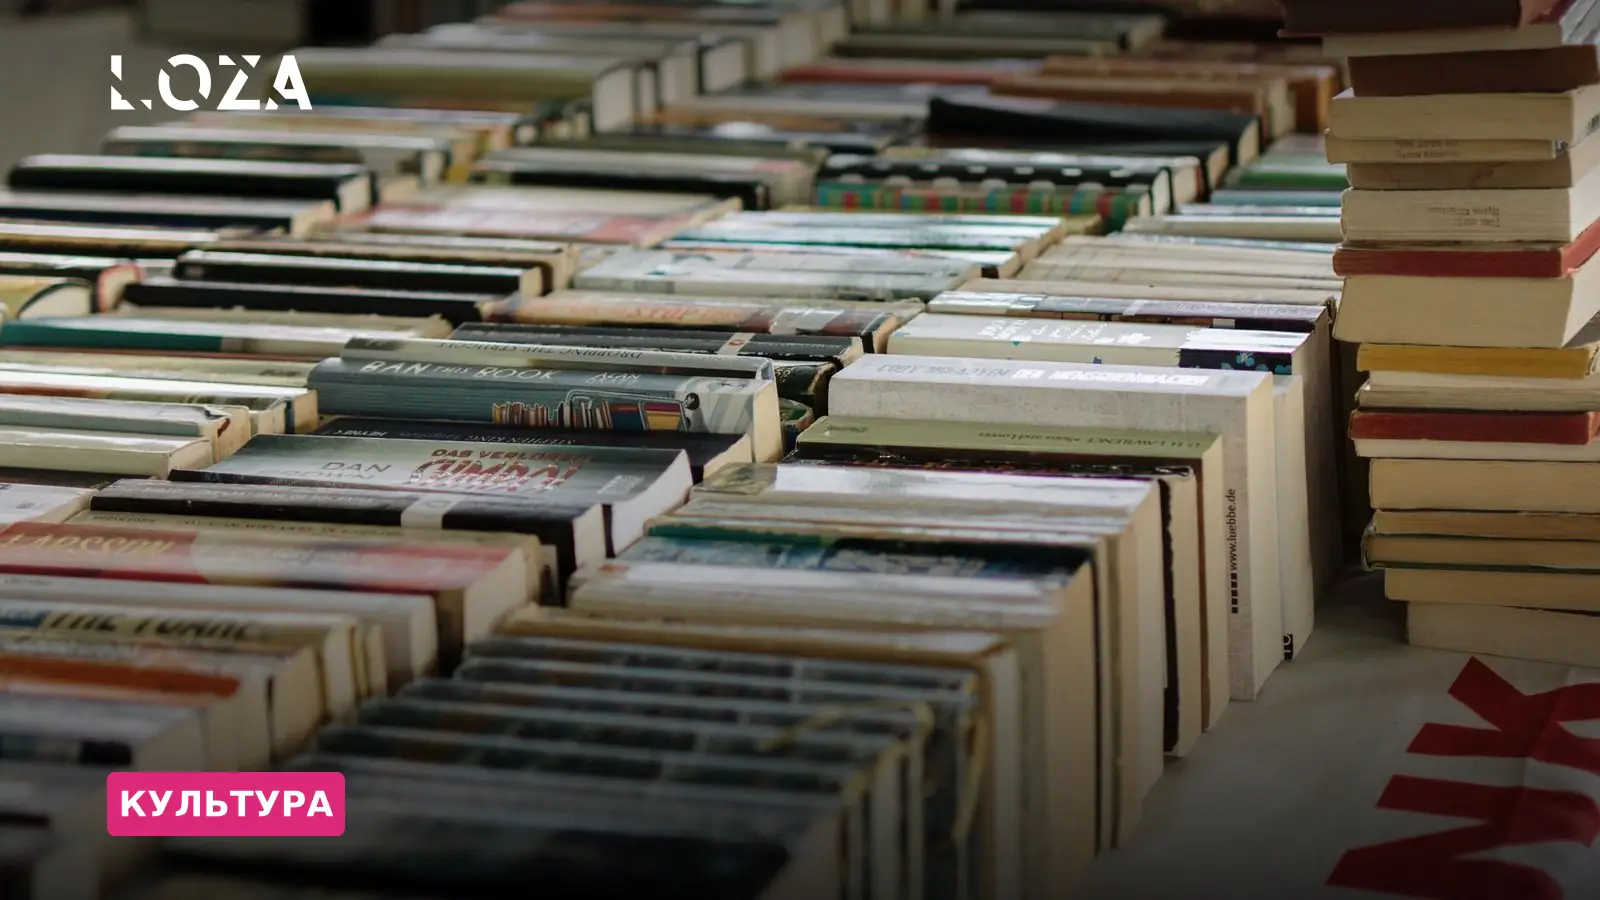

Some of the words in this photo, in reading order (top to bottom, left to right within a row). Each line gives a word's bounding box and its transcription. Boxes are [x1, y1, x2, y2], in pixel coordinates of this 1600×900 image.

[360, 360, 433, 375] BAN
[433, 365, 475, 374] THIS
[472, 366, 562, 381] BOOK
[431, 448, 474, 459] DAS
[320, 461, 393, 473] DAN
[1225, 488, 1238, 572] www.luebbe.de
